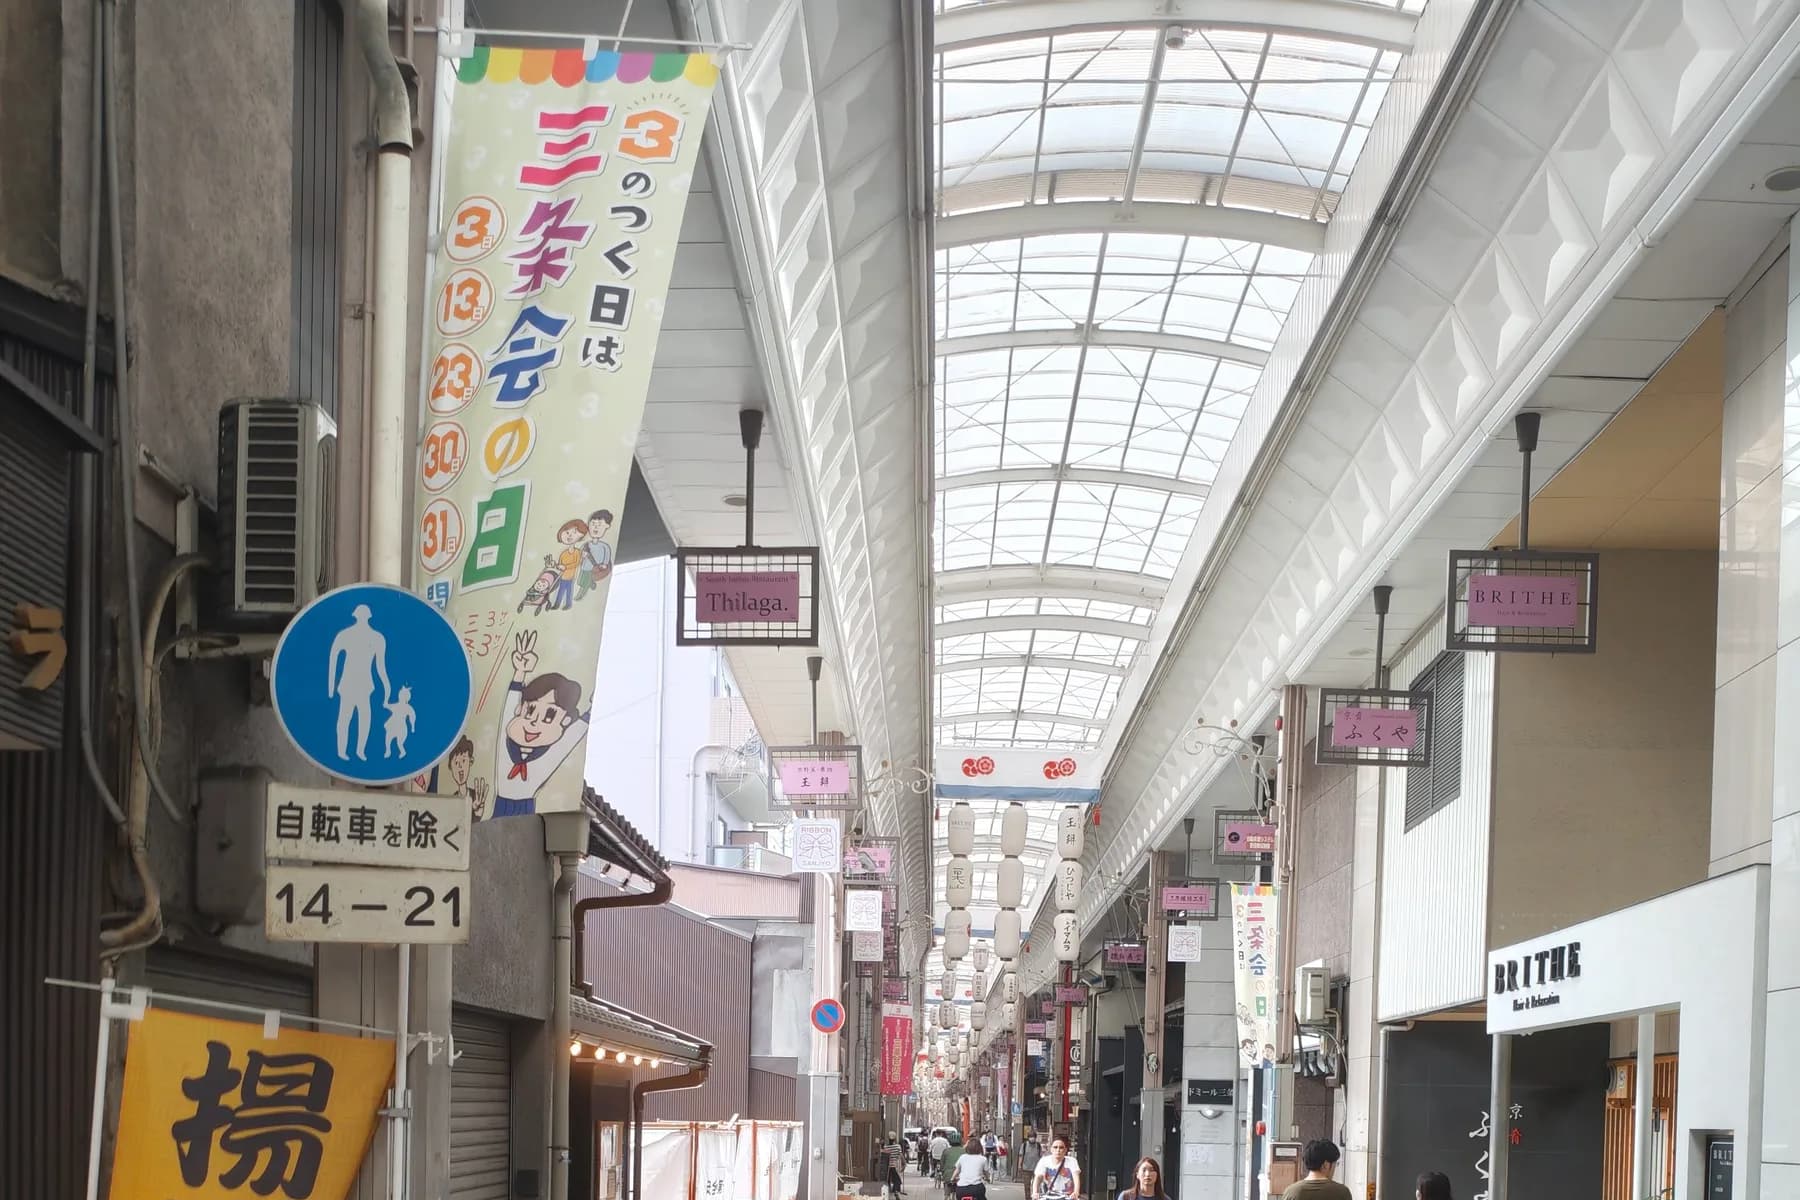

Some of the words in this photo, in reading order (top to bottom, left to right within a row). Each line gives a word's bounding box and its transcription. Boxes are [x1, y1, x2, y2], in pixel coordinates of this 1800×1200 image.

[582, 110, 682, 368] 3のつく日は
[461, 106, 609, 588] 三条会の日
[705, 592, 788, 616] Thilaga.
[1475, 589, 1572, 605] BRITHE
[1345, 724, 1409, 742] ふくや
[276, 801, 460, 852] 自転車を除く
[801, 826, 832, 834] RIBBON
[1064, 866, 1076, 901] ひつじや
[1493, 941, 1581, 995] BRITHE
